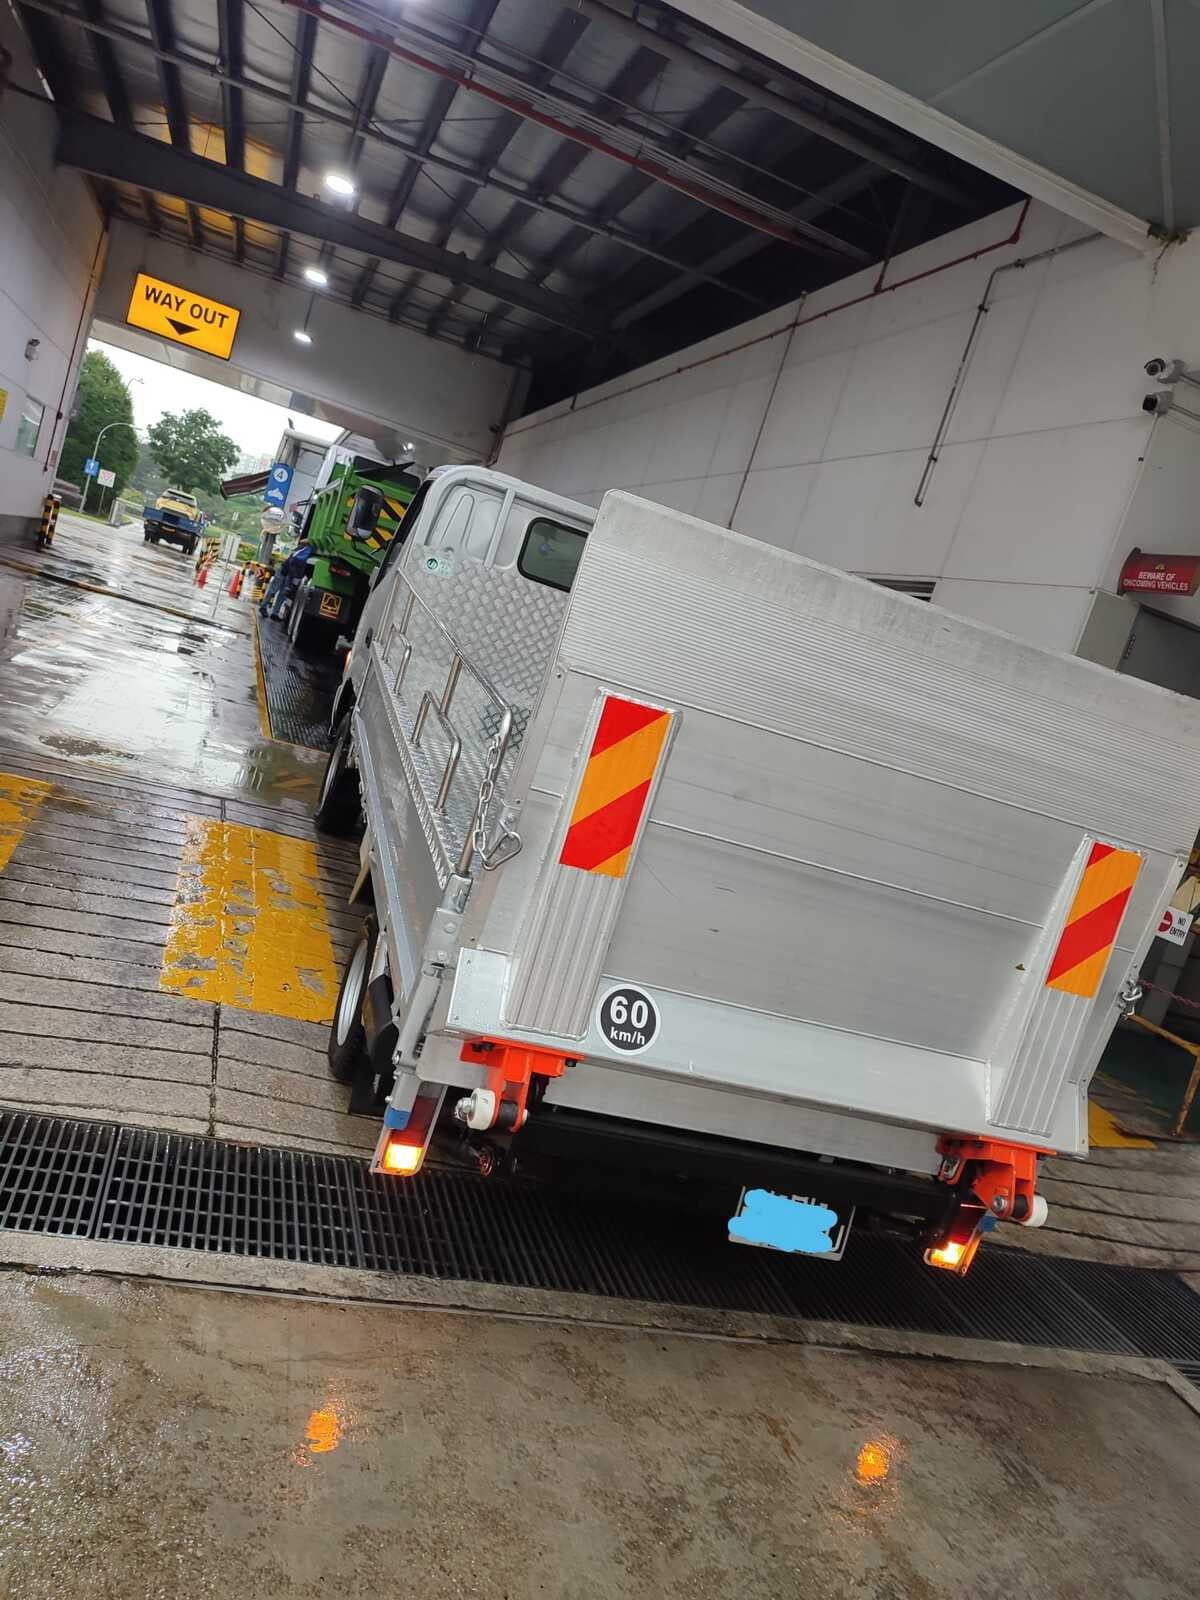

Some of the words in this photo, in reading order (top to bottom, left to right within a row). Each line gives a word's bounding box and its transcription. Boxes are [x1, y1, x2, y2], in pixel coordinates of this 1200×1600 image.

[145, 285, 186, 312] WAY
[190, 303, 229, 328] OUT
[1123, 579, 1156, 588] ONCOMING
[1157, 581, 1188, 591] VEHICLES
[1138, 571, 1166, 580] BEWARE
[1166, 573, 1176, 581] OF
[610, 996, 648, 1029] 60
[610, 1026, 645, 1045] km/h
